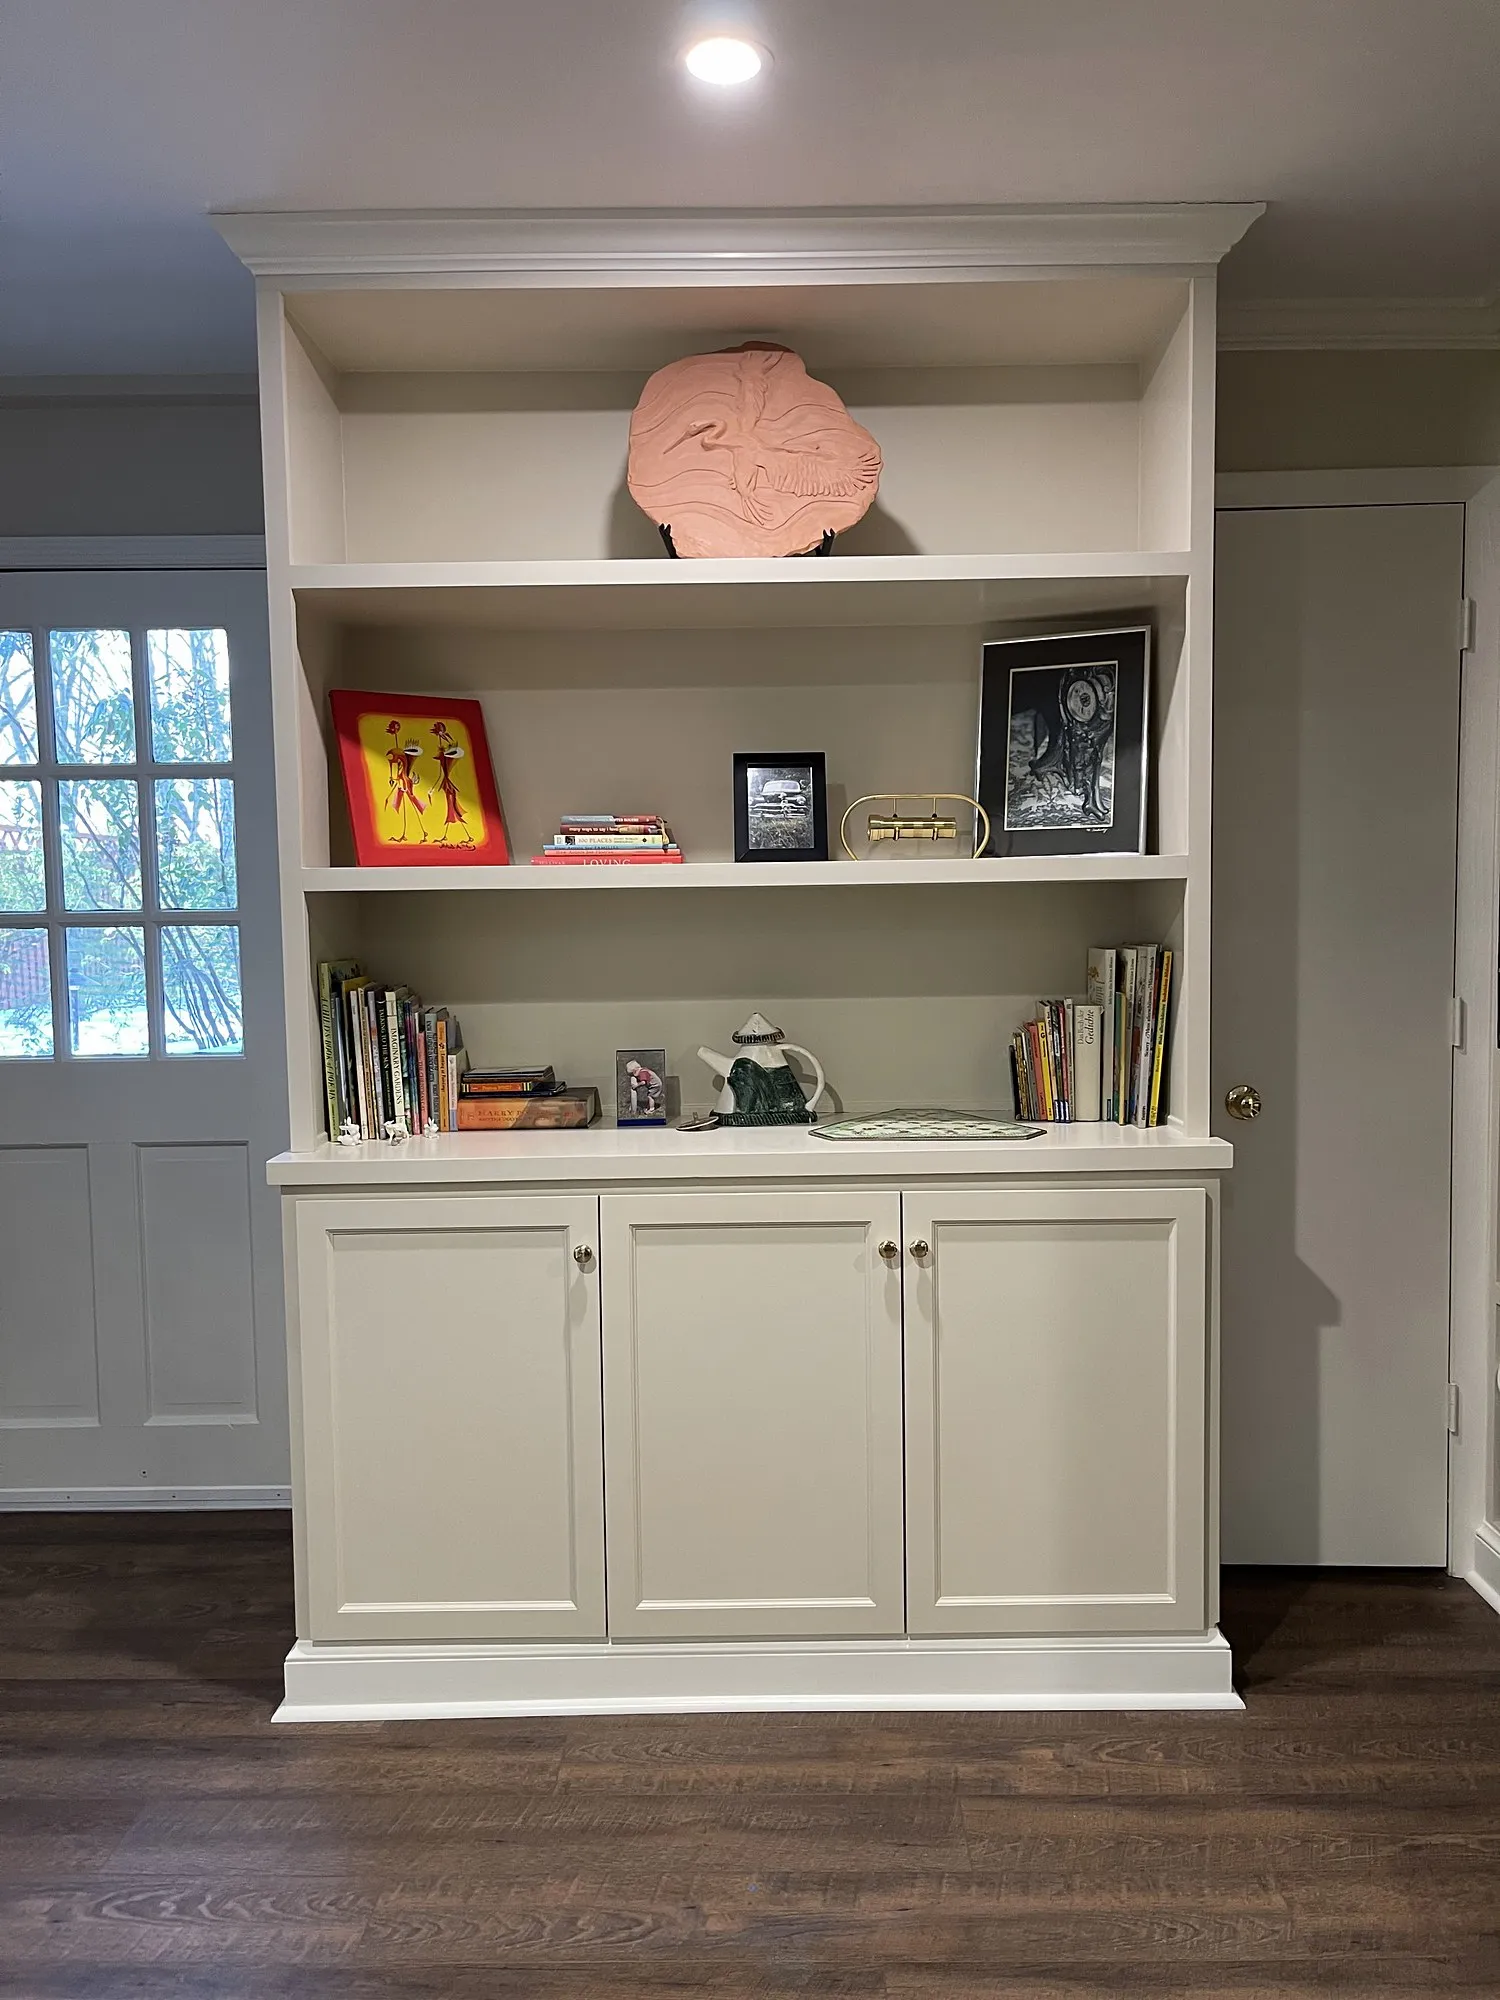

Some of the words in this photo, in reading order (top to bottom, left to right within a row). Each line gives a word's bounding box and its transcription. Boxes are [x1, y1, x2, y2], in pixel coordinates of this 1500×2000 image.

[1084, 1009, 1095, 1045] Gedichte
[325, 1039, 333, 1060] BOOK
[391, 1028, 400, 1070] IMAGINARY
[327, 1071, 336, 1100] POEMS
[394, 1071, 403, 1105] GARDENS
